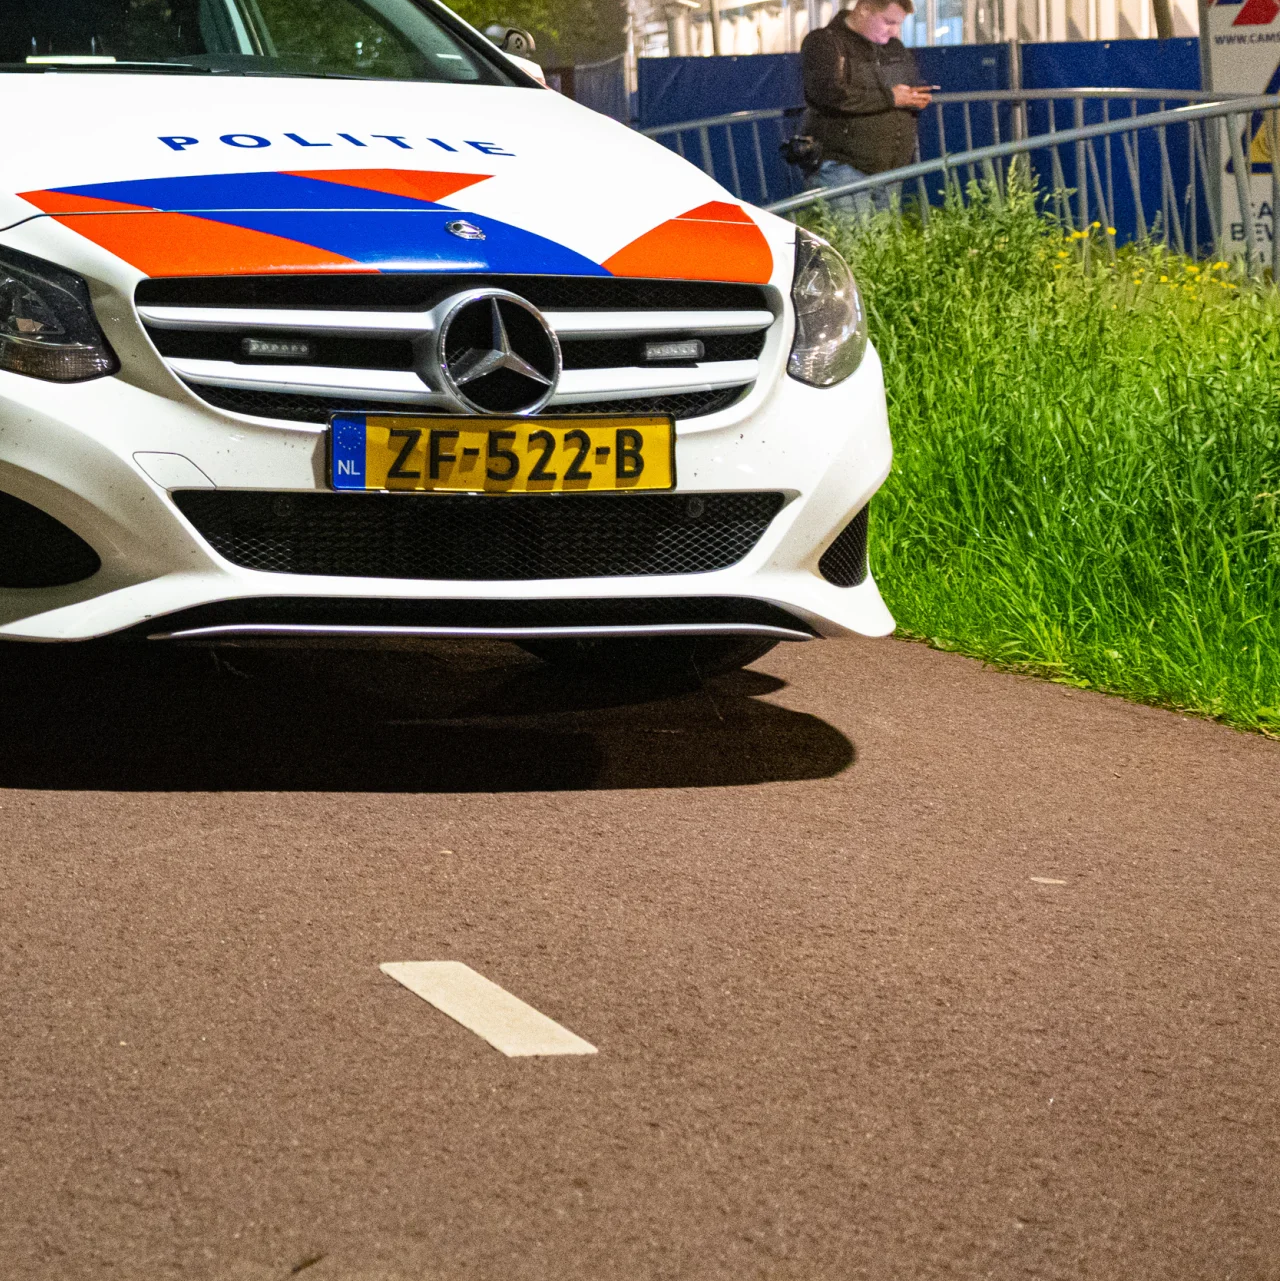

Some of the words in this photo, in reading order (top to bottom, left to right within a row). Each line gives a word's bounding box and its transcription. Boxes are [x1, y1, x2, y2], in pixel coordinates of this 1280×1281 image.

[157, 132, 514, 157] POLITIE
[387, 428, 645, 481] ZF-522-B
[337, 460, 361, 476] NL
